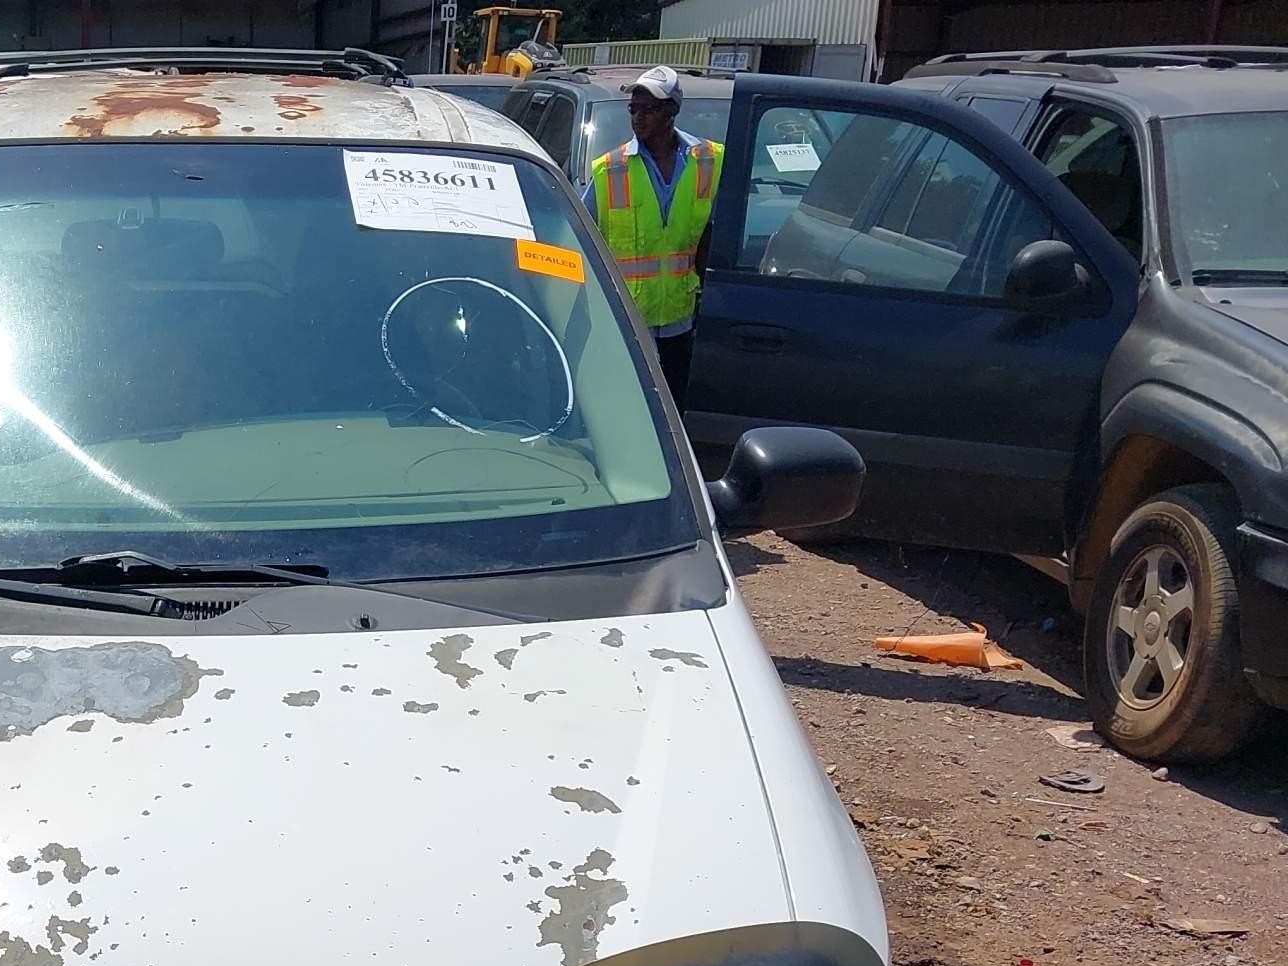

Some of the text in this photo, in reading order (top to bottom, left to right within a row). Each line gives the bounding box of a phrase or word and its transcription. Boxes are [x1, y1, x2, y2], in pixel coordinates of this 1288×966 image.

[442, 6, 455, 18] 10
[364, 168, 497, 191] 45836611
[524, 251, 577, 269] DETAILED
